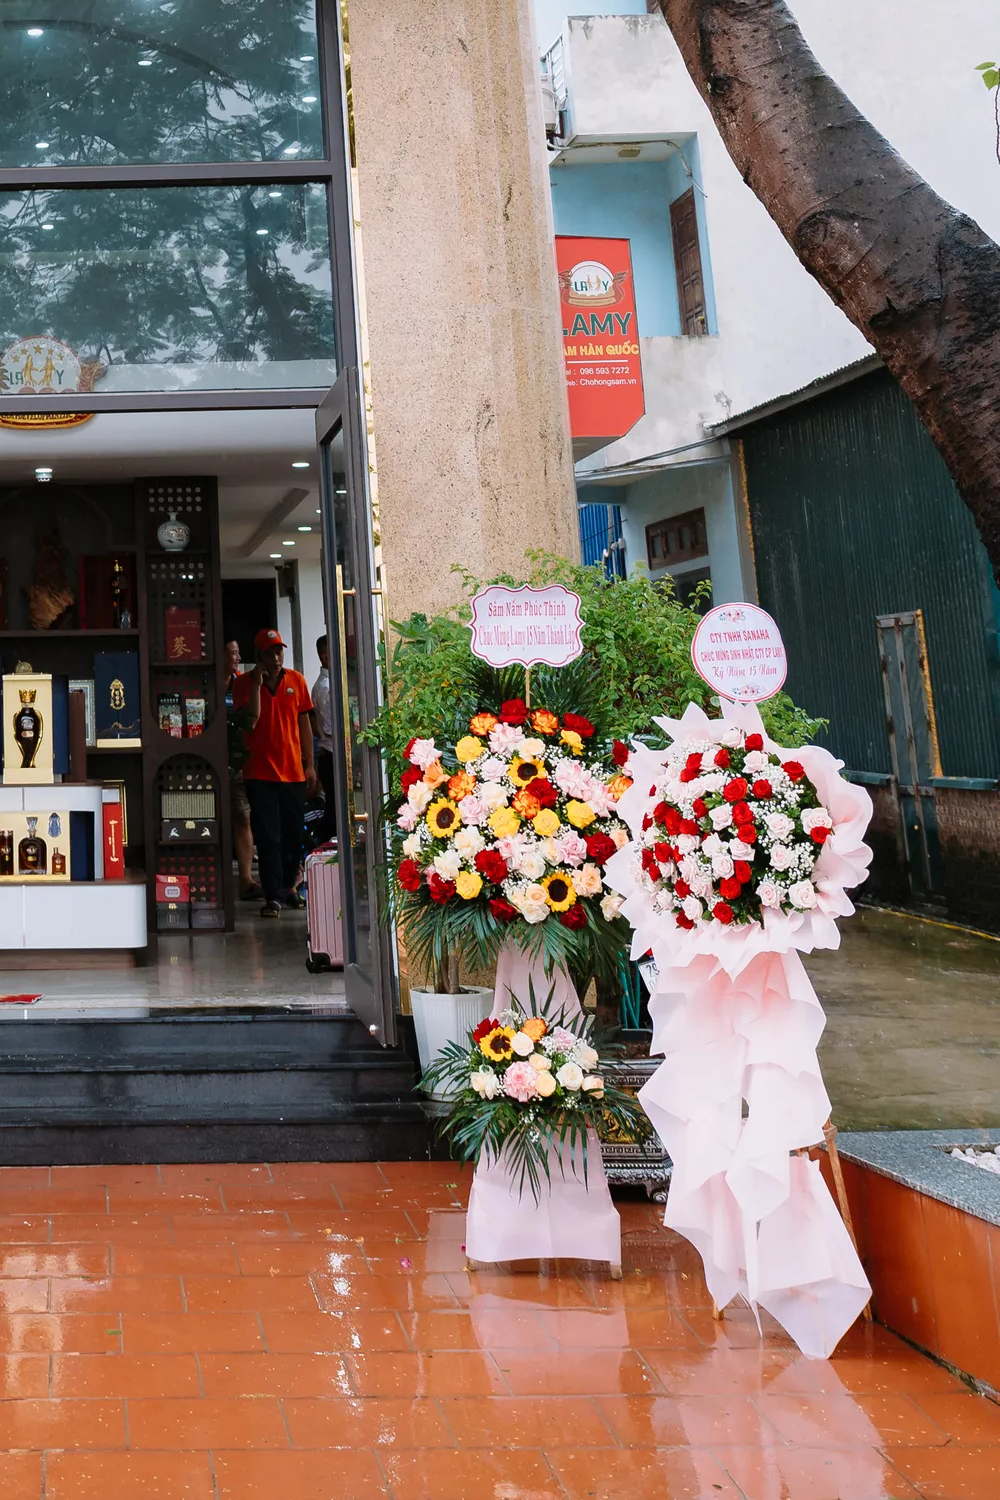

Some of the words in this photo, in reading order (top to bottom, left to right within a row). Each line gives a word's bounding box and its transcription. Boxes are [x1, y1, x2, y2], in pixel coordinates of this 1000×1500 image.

[562, 311, 632, 336] AMY
[580, 343, 603, 355] HÀN
[606, 340, 639, 355] QUỐC
[580, 367, 594, 375] 096
[611, 366, 629, 374] 7272
[580, 378, 636, 386] Chohongsam.vn
[488, 601, 504, 617] Sâm
[524, 600, 542, 616] Phúc
[544, 600, 566, 620] Thịnh
[479, 625, 493, 646] Chúc
[493, 625, 510, 651] Mừng
[511, 625, 525, 651] Lamy
[533, 624, 546, 645] Năm
[546, 624, 564, 645] Thành
[709, 632, 722, 643] CTY
[723, 631, 742, 642] TNHH
[743, 629, 770, 641] SANAHA
[701, 649, 714, 662] CHÚC
[730, 649, 741, 660] SINH
[755, 648, 765, 659] CTY
[765, 648, 771, 658] CP
[749, 665, 756, 675] 15
[759, 664, 777, 675] Năm
